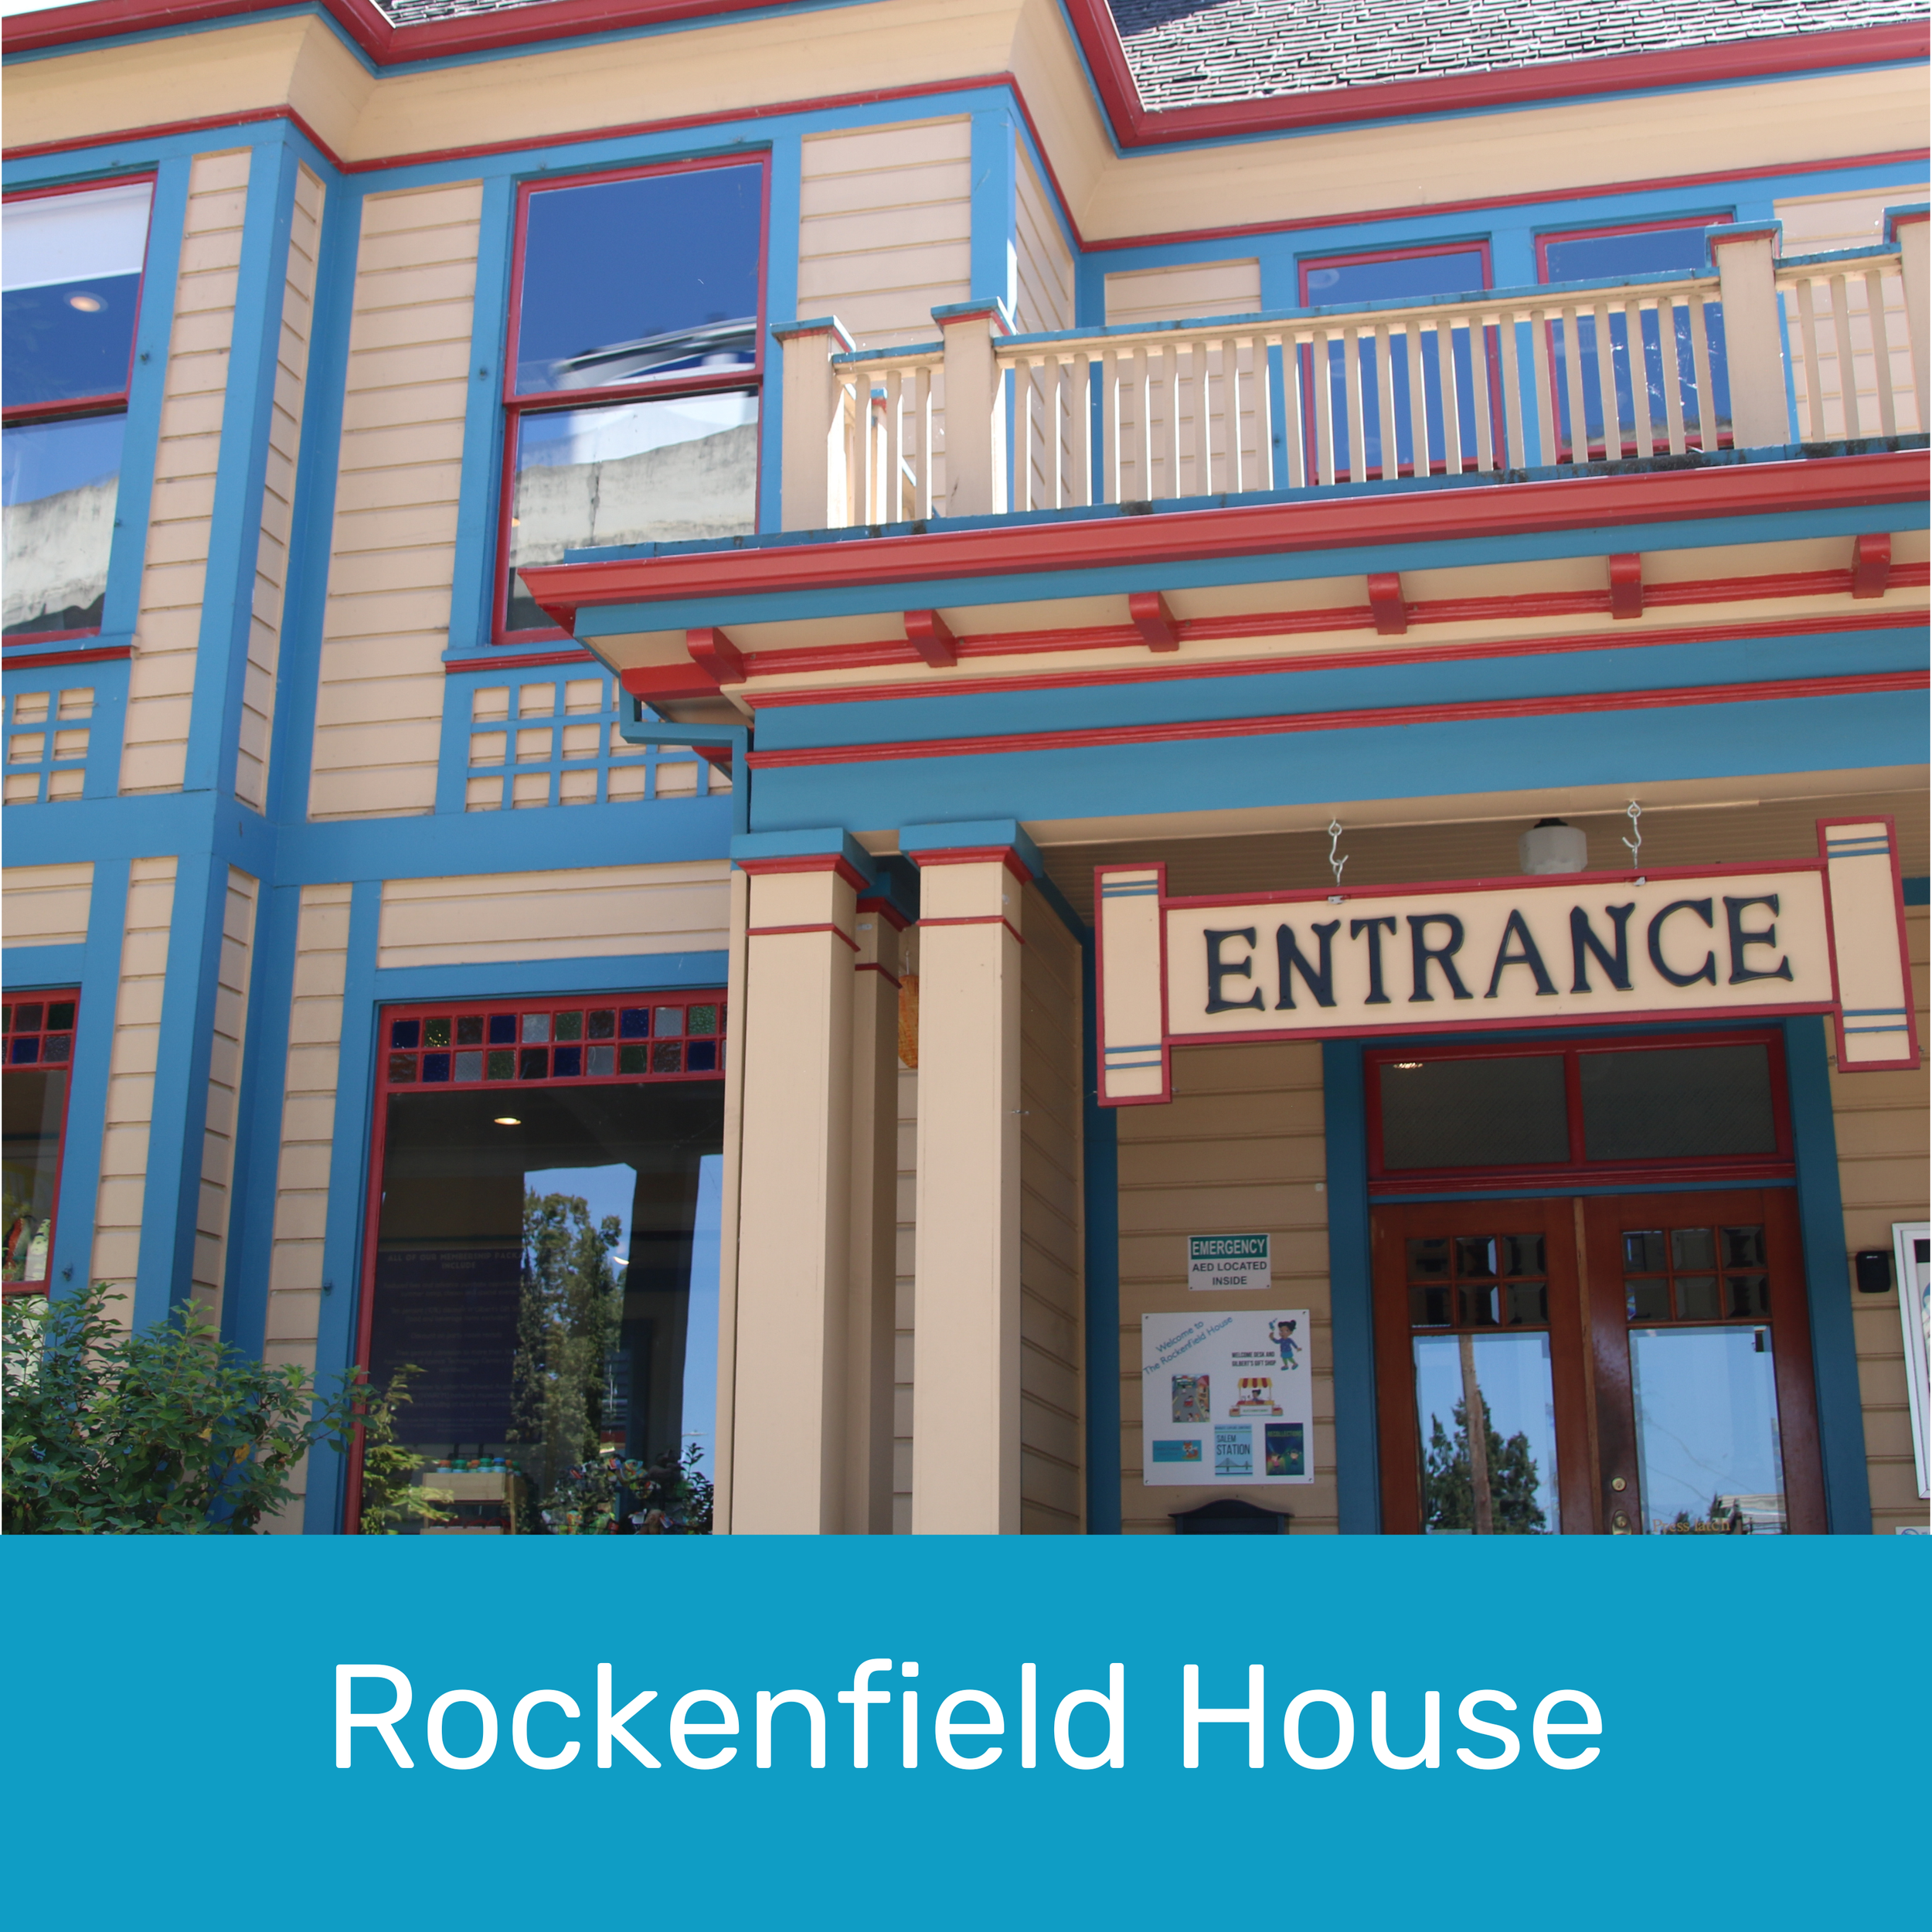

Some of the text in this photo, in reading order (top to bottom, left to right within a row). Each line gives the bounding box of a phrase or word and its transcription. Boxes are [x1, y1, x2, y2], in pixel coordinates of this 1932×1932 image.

[1203, 893, 1794, 1015] ENTRANCE
[1192, 1239, 1265, 1256] EMERGENCY
[440, 1252, 492, 1260] MEMBERSHIP
[441, 1261, 476, 1270] INCLUDE
[1192, 1261, 1267, 1272] AED LOCATED
[1213, 1276, 1247, 1285] INSIDE
[1155, 1321, 1204, 1352] Welcome to
[1143, 1317, 1233, 1375] The Rockenfield House
[1216, 1434, 1236, 1443] SALEM
[1216, 1444, 1250, 1455] STATION
[1652, 1519, 1731, 1532] Press latch
